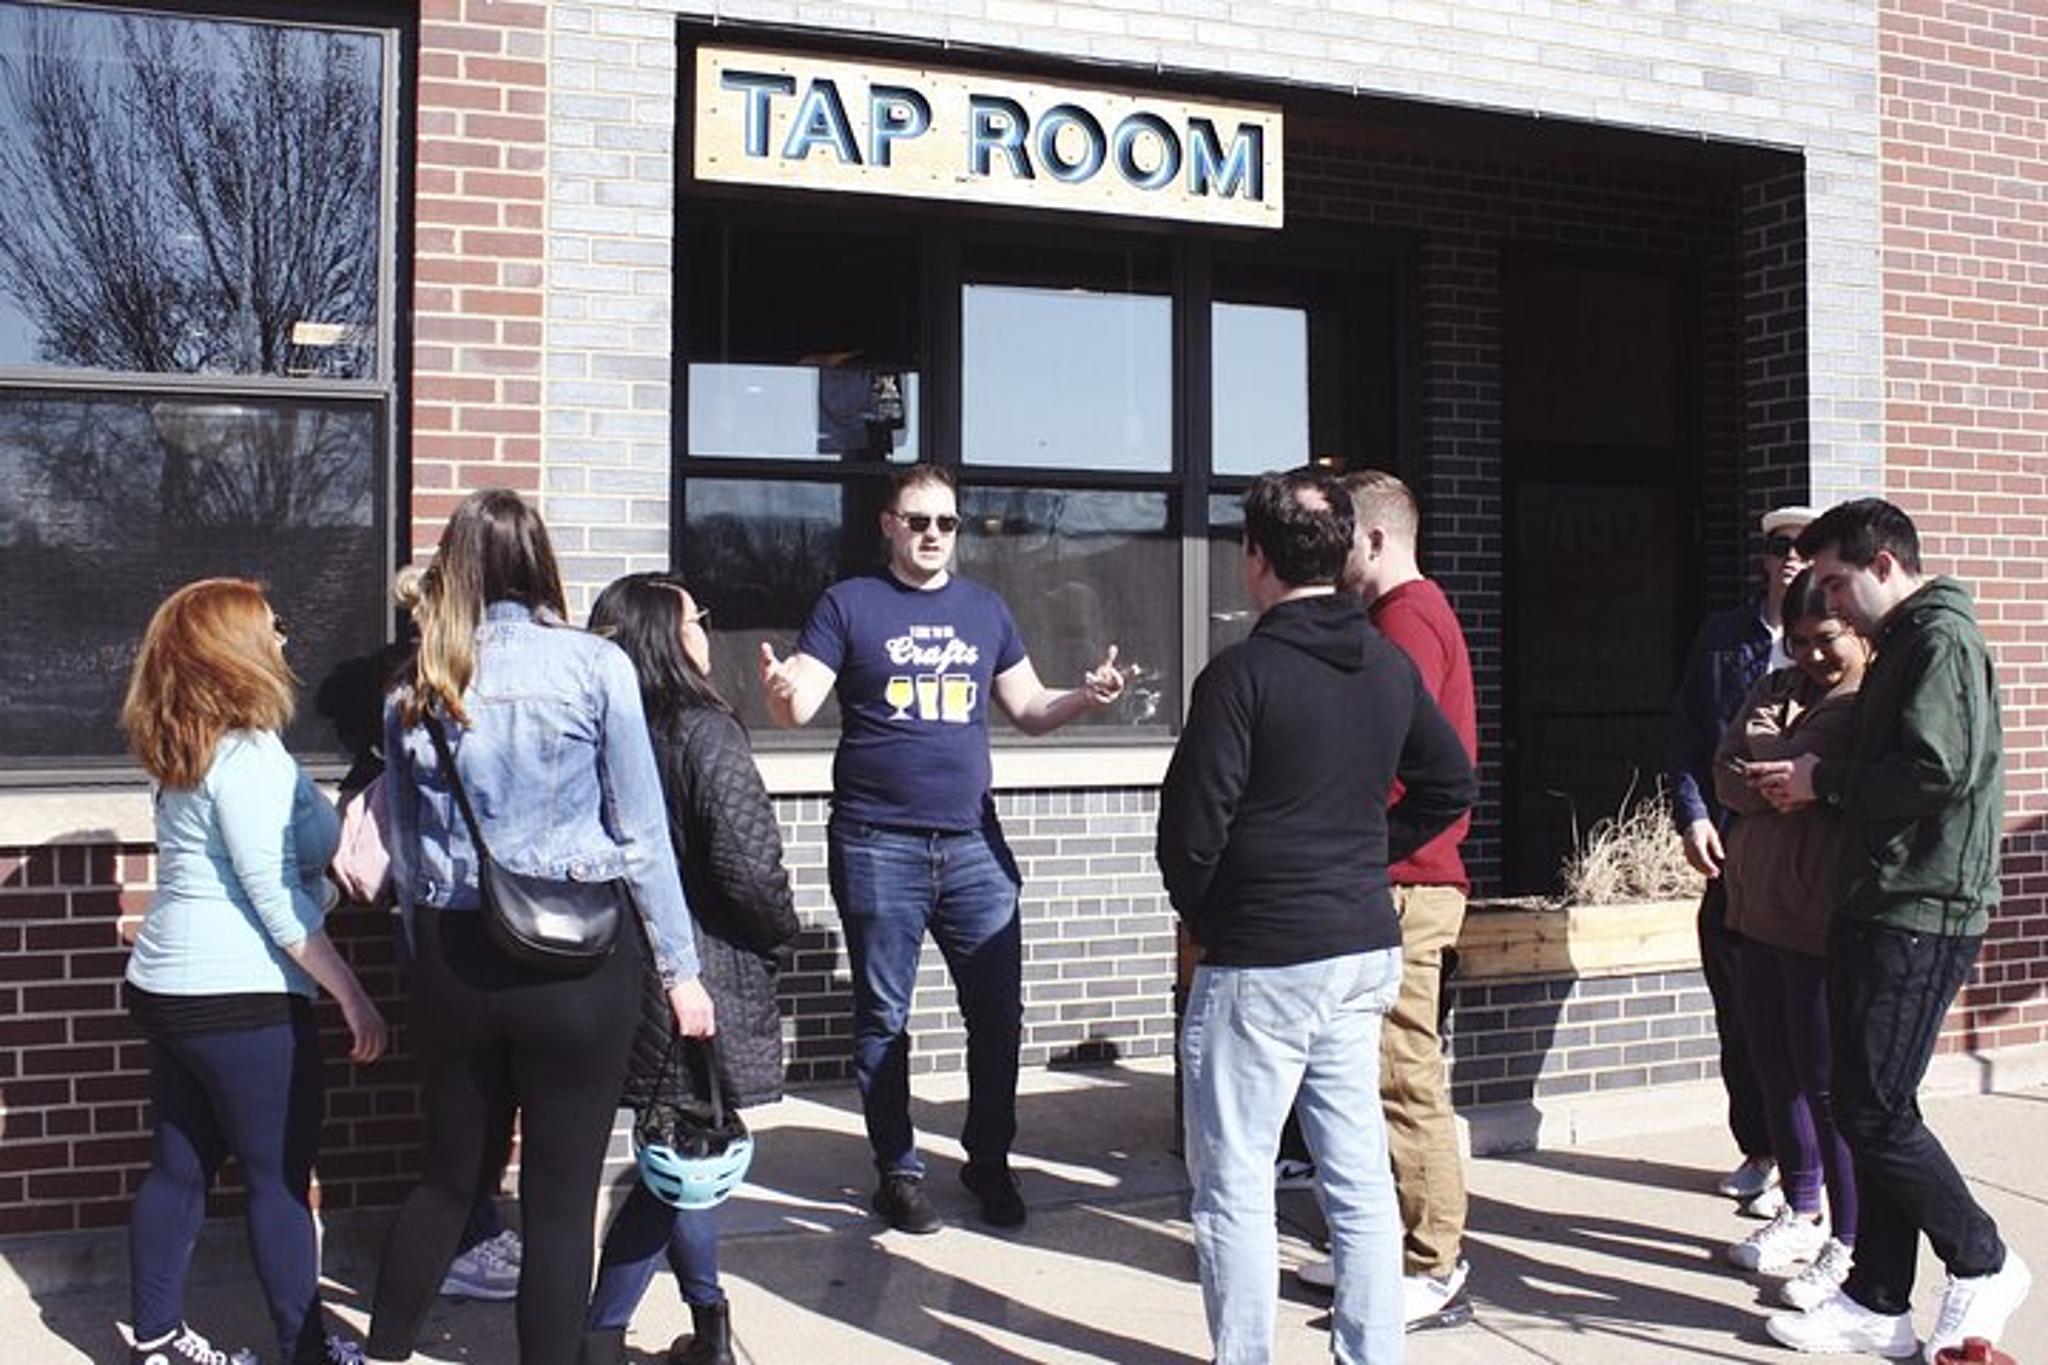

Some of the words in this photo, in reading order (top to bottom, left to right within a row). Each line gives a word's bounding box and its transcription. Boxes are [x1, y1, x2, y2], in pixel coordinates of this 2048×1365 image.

[721, 70, 931, 167] TAP
[968, 94, 1265, 201] ROOM
[886, 636, 979, 674] Crafts
